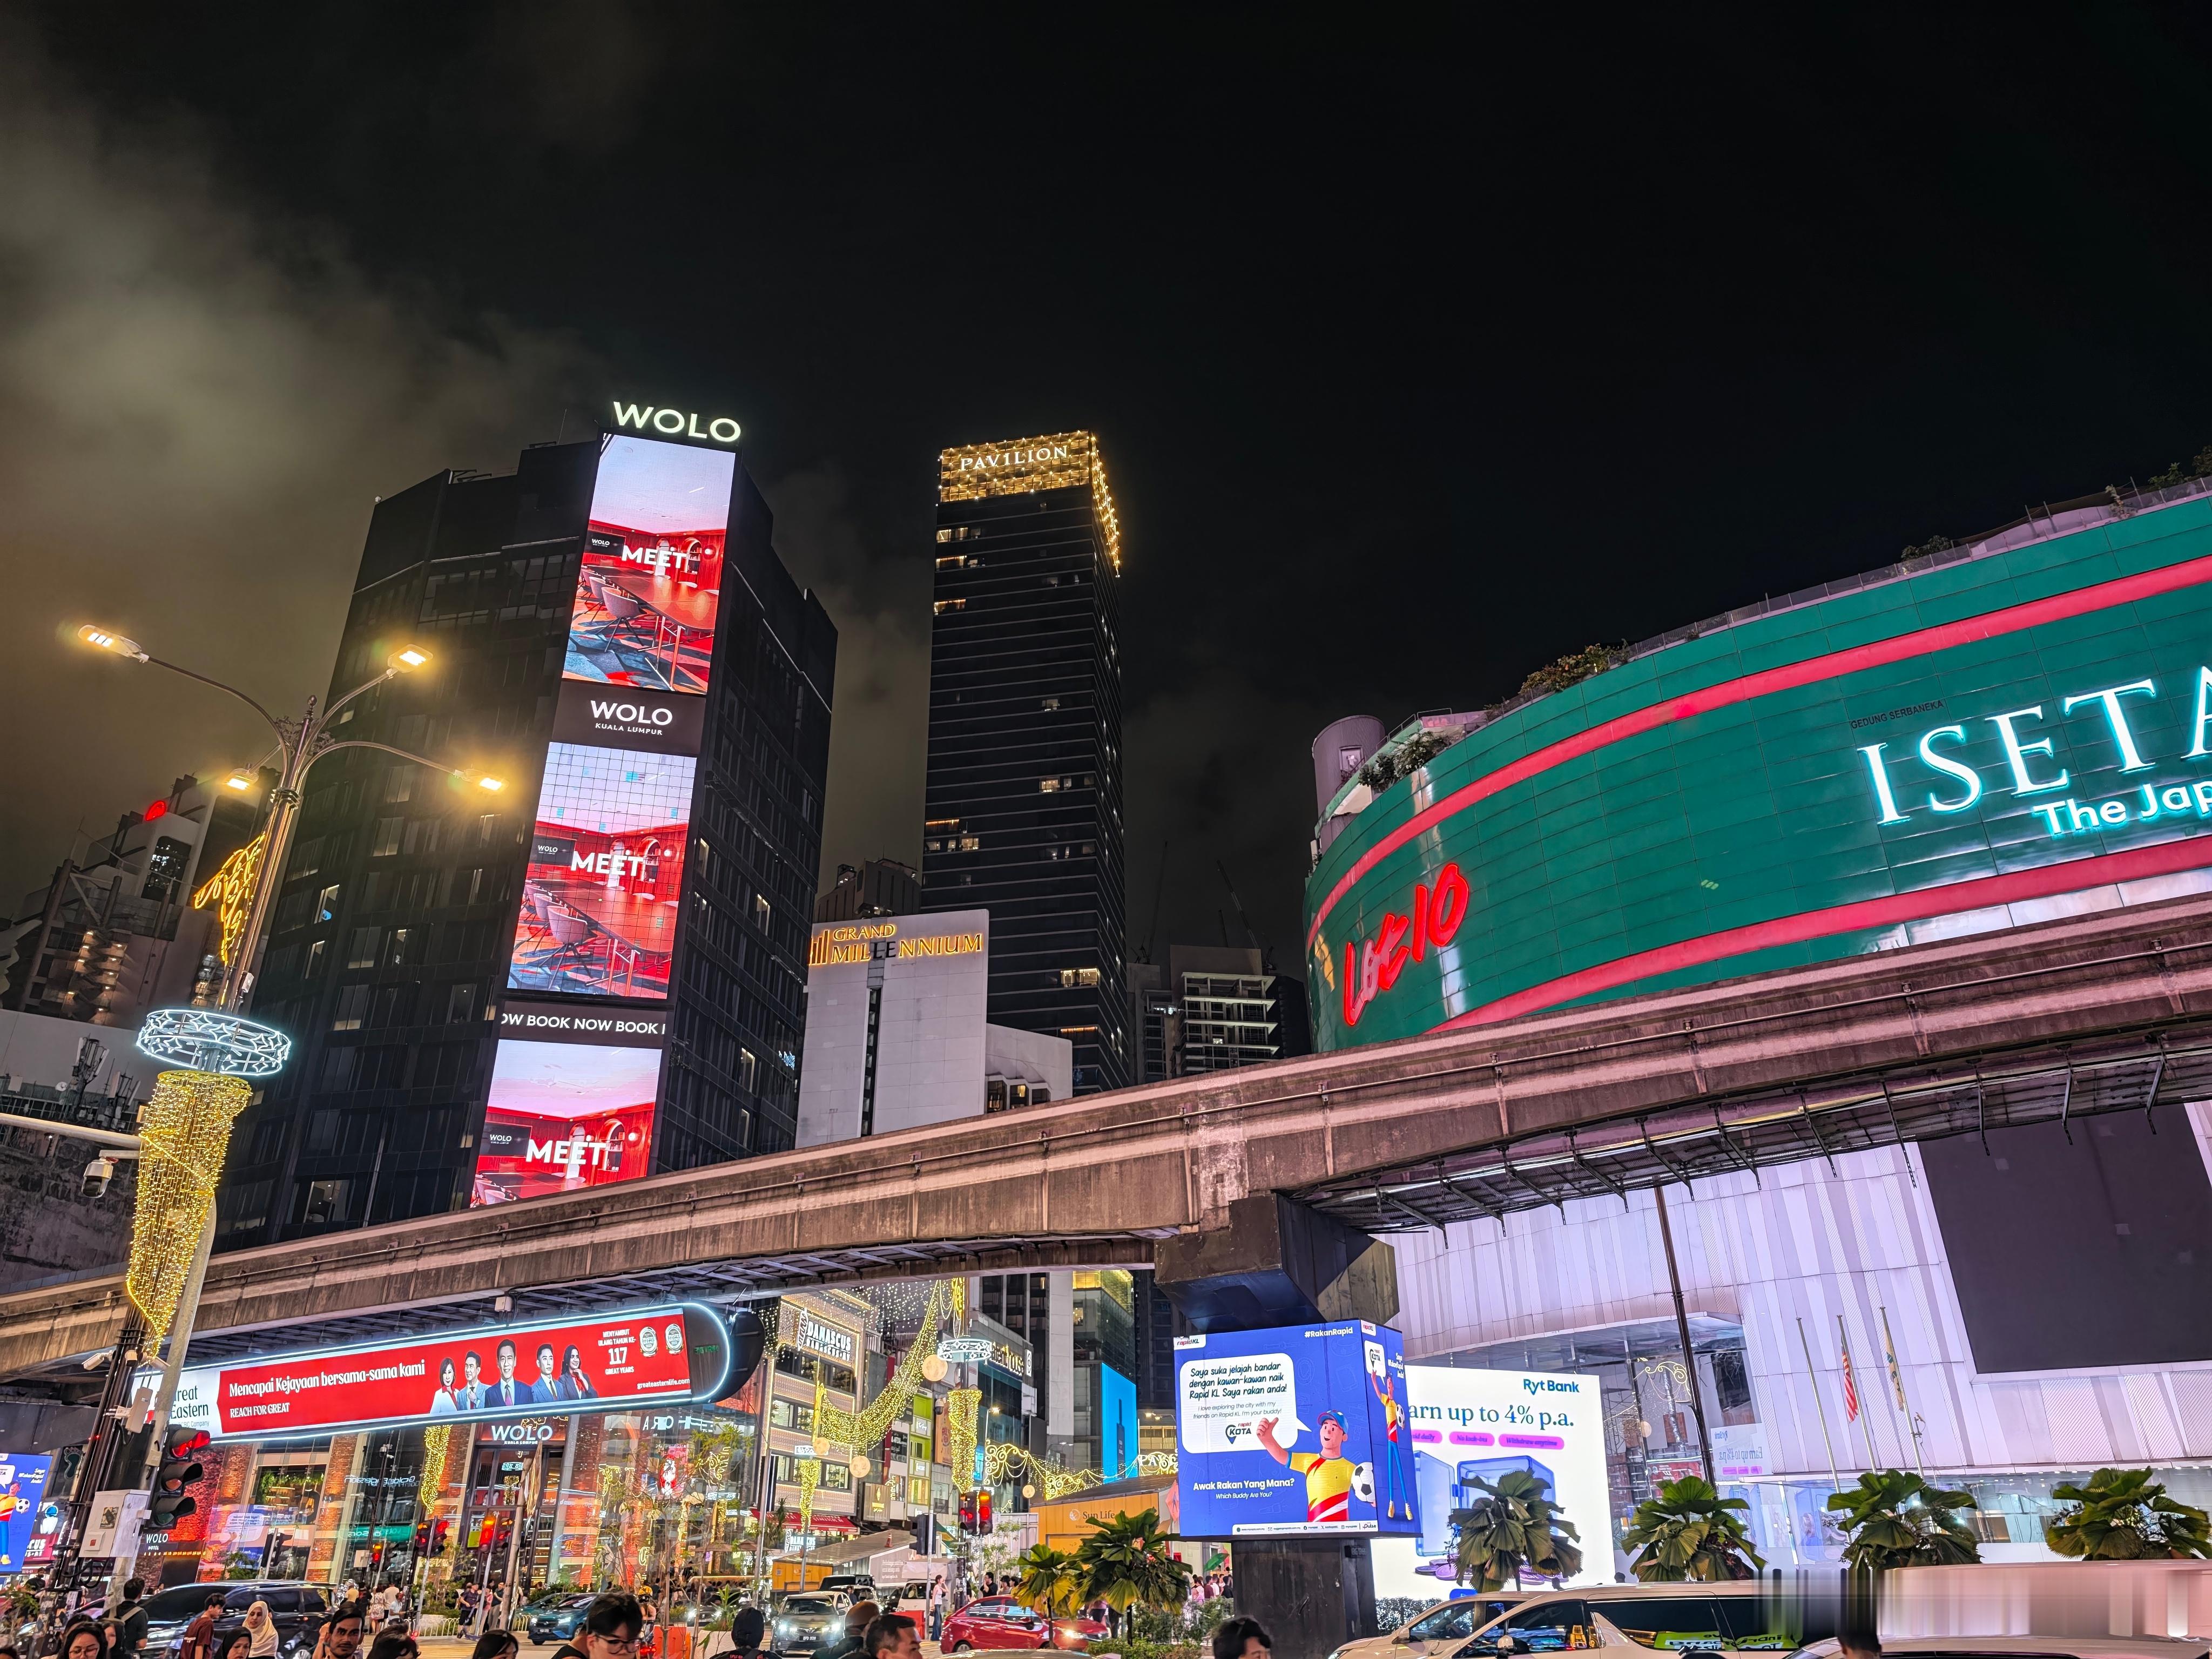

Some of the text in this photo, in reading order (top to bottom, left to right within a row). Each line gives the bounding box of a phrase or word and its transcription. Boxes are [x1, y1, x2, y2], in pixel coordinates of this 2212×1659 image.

[613, 401, 741, 442] WOLO
[960, 445, 1069, 471] PAVILION
[592, 538, 610, 546] WOLO
[622, 545, 687, 569] MEET
[590, 700, 672, 725] WOLO
[1851, 700, 1944, 729] GEDUNG SERBANEKA
[595, 723, 663, 736] KUALA LUMPUR
[2033, 797, 2126, 837] The
[538, 844, 558, 853] WOLO
[570, 851, 644, 876] MEET
[1412, 863, 1469, 963] 10
[833, 924, 896, 942] GRAND
[831, 933, 983, 964] MILLENNIUM
[527, 1015, 571, 1029] BOOK
[574, 1019, 612, 1031] NOW
[616, 1021, 658, 1035] BOOK
[490, 1134, 512, 1142] WOLO
[525, 1139, 607, 1165] MEET
[603, 1328, 630, 1337] MENYAMBUT
[1304, 1327, 1353, 1338] #RakanRapid
[608, 1346, 628, 1365] 117
[605, 1367, 619, 1375] GREAT
[1190, 1362, 1281, 1378] Saya suka jelajah bandar
[229, 1359, 426, 1398] Mencapai Kejayaan bersama-sama kami
[637, 1378, 690, 1390] greateasternlife.com
[1189, 1372, 1284, 1390] dengan kawan-kawan naik
[173, 1385, 198, 1402] reat
[1190, 1384, 1287, 1401] Rapid KL Saya rakan anda!
[1523, 1379, 1580, 1395] Ryt Bank
[170, 1404, 208, 1419] Eastern
[230, 1402, 290, 1418] REACH FOR GREAT
[1212, 1404, 1235, 1412] exploring
[1263, 1408, 1282, 1417] buddy!
[1408, 1405, 1574, 1431] arn up to 4% p.a.
[491, 1425, 553, 1441] WOLO
[1230, 1428, 1251, 1436] KOTA
[1193, 1478, 1294, 1491] Awak Rakan Yang Mana?
[1083, 1510, 1115, 1520] Sun Life
[146, 1533, 168, 1543] WOLO
